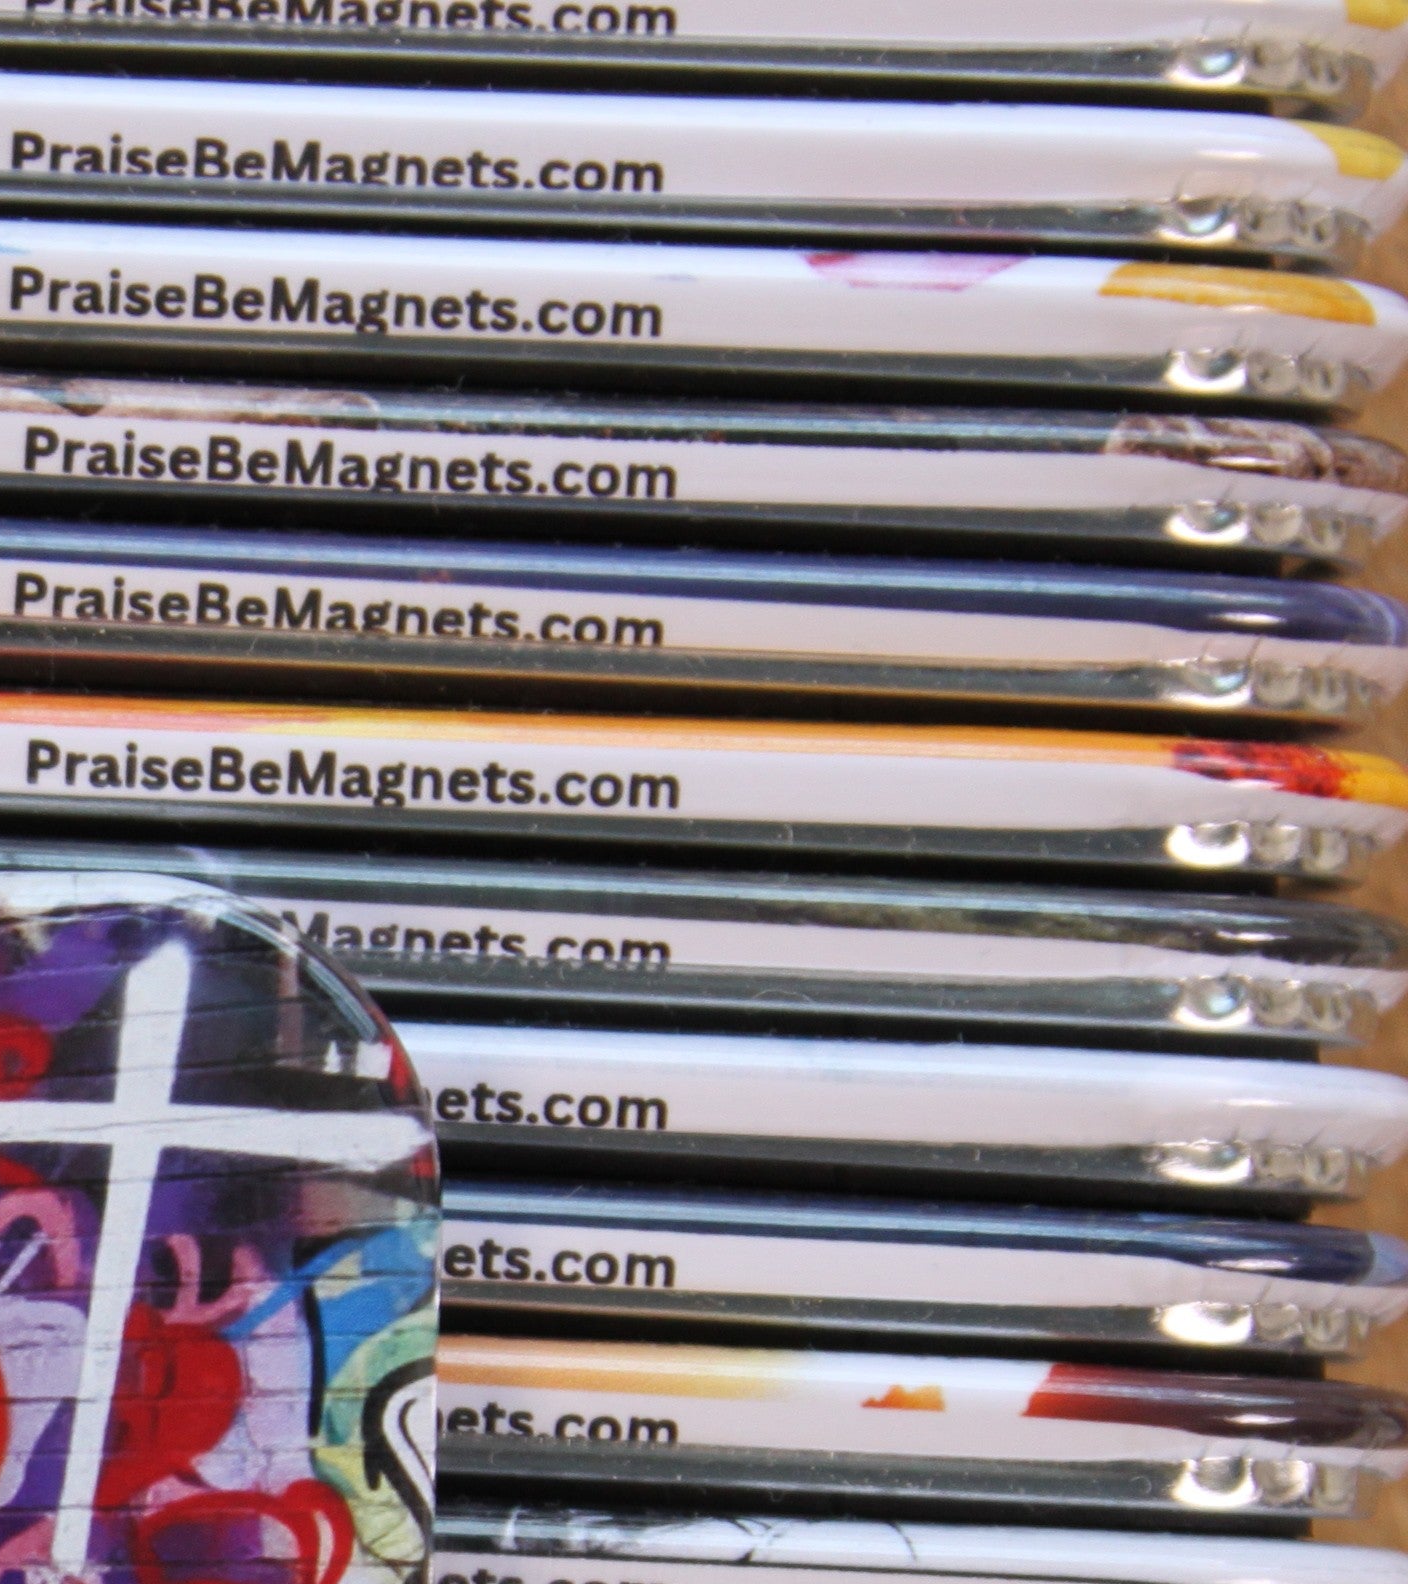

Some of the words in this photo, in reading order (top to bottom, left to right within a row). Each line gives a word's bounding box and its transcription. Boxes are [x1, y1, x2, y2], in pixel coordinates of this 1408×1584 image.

[12, 130, 665, 193] PraiseBeMagnets.com
[9, 265, 663, 338] PraiseBeMagnets.com
[24, 425, 678, 500] PraiseBeMagnets.com
[14, 571, 665, 647] PraiseBeMagnets.com
[26, 738, 681, 811] PraiseBeMagnets.com
